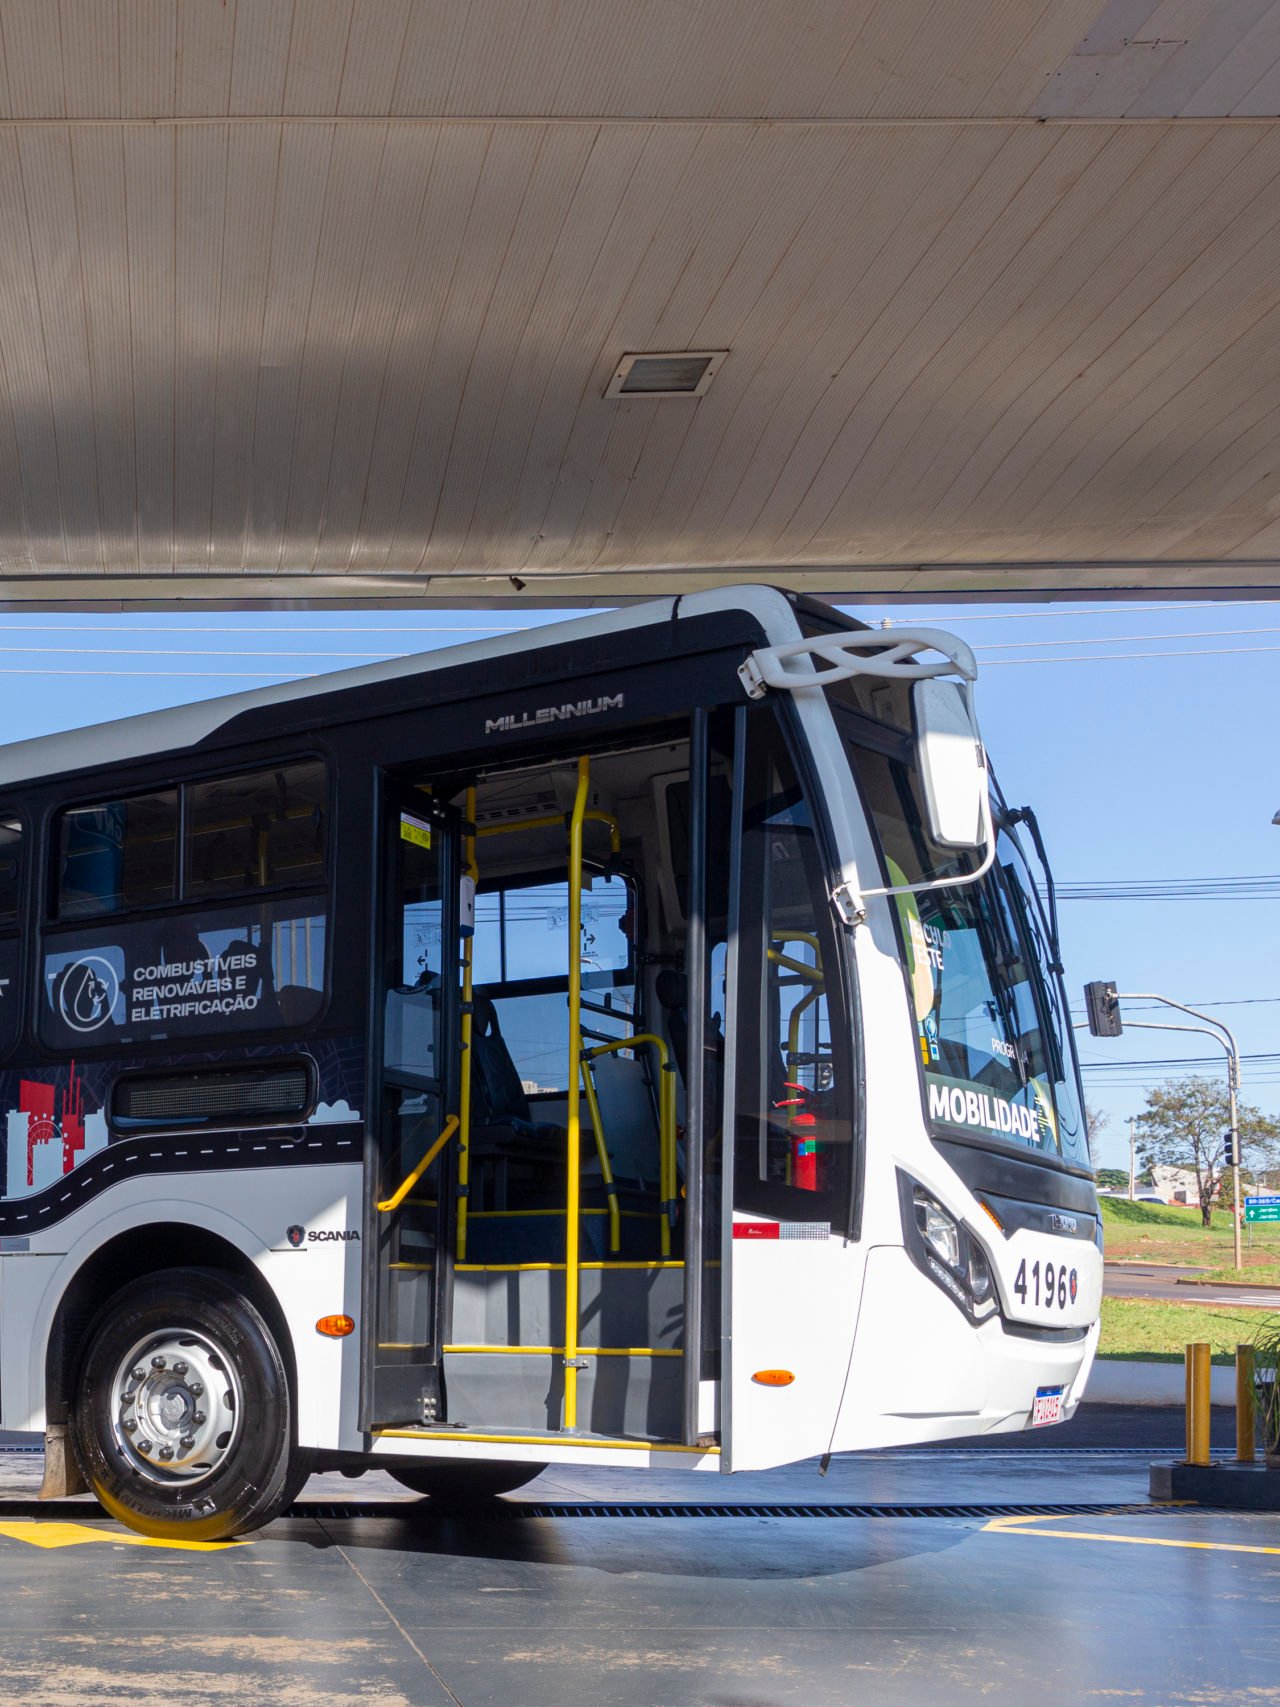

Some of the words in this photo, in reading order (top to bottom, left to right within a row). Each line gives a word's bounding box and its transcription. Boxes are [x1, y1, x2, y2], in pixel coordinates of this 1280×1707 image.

[485, 693, 624, 734] MILLENNIUM
[133, 953, 257, 981] COMBUSTÍVEIS
[132, 975, 232, 1002] RENOVÁVEIS
[235, 975, 246, 990] E
[131, 994, 258, 1022] ELETRIFICAÇÃO
[929, 1084, 1041, 1143] MOBILIDADE
[307, 1230, 361, 1242] SCANIA
[1013, 1257, 1067, 1311] 4196
